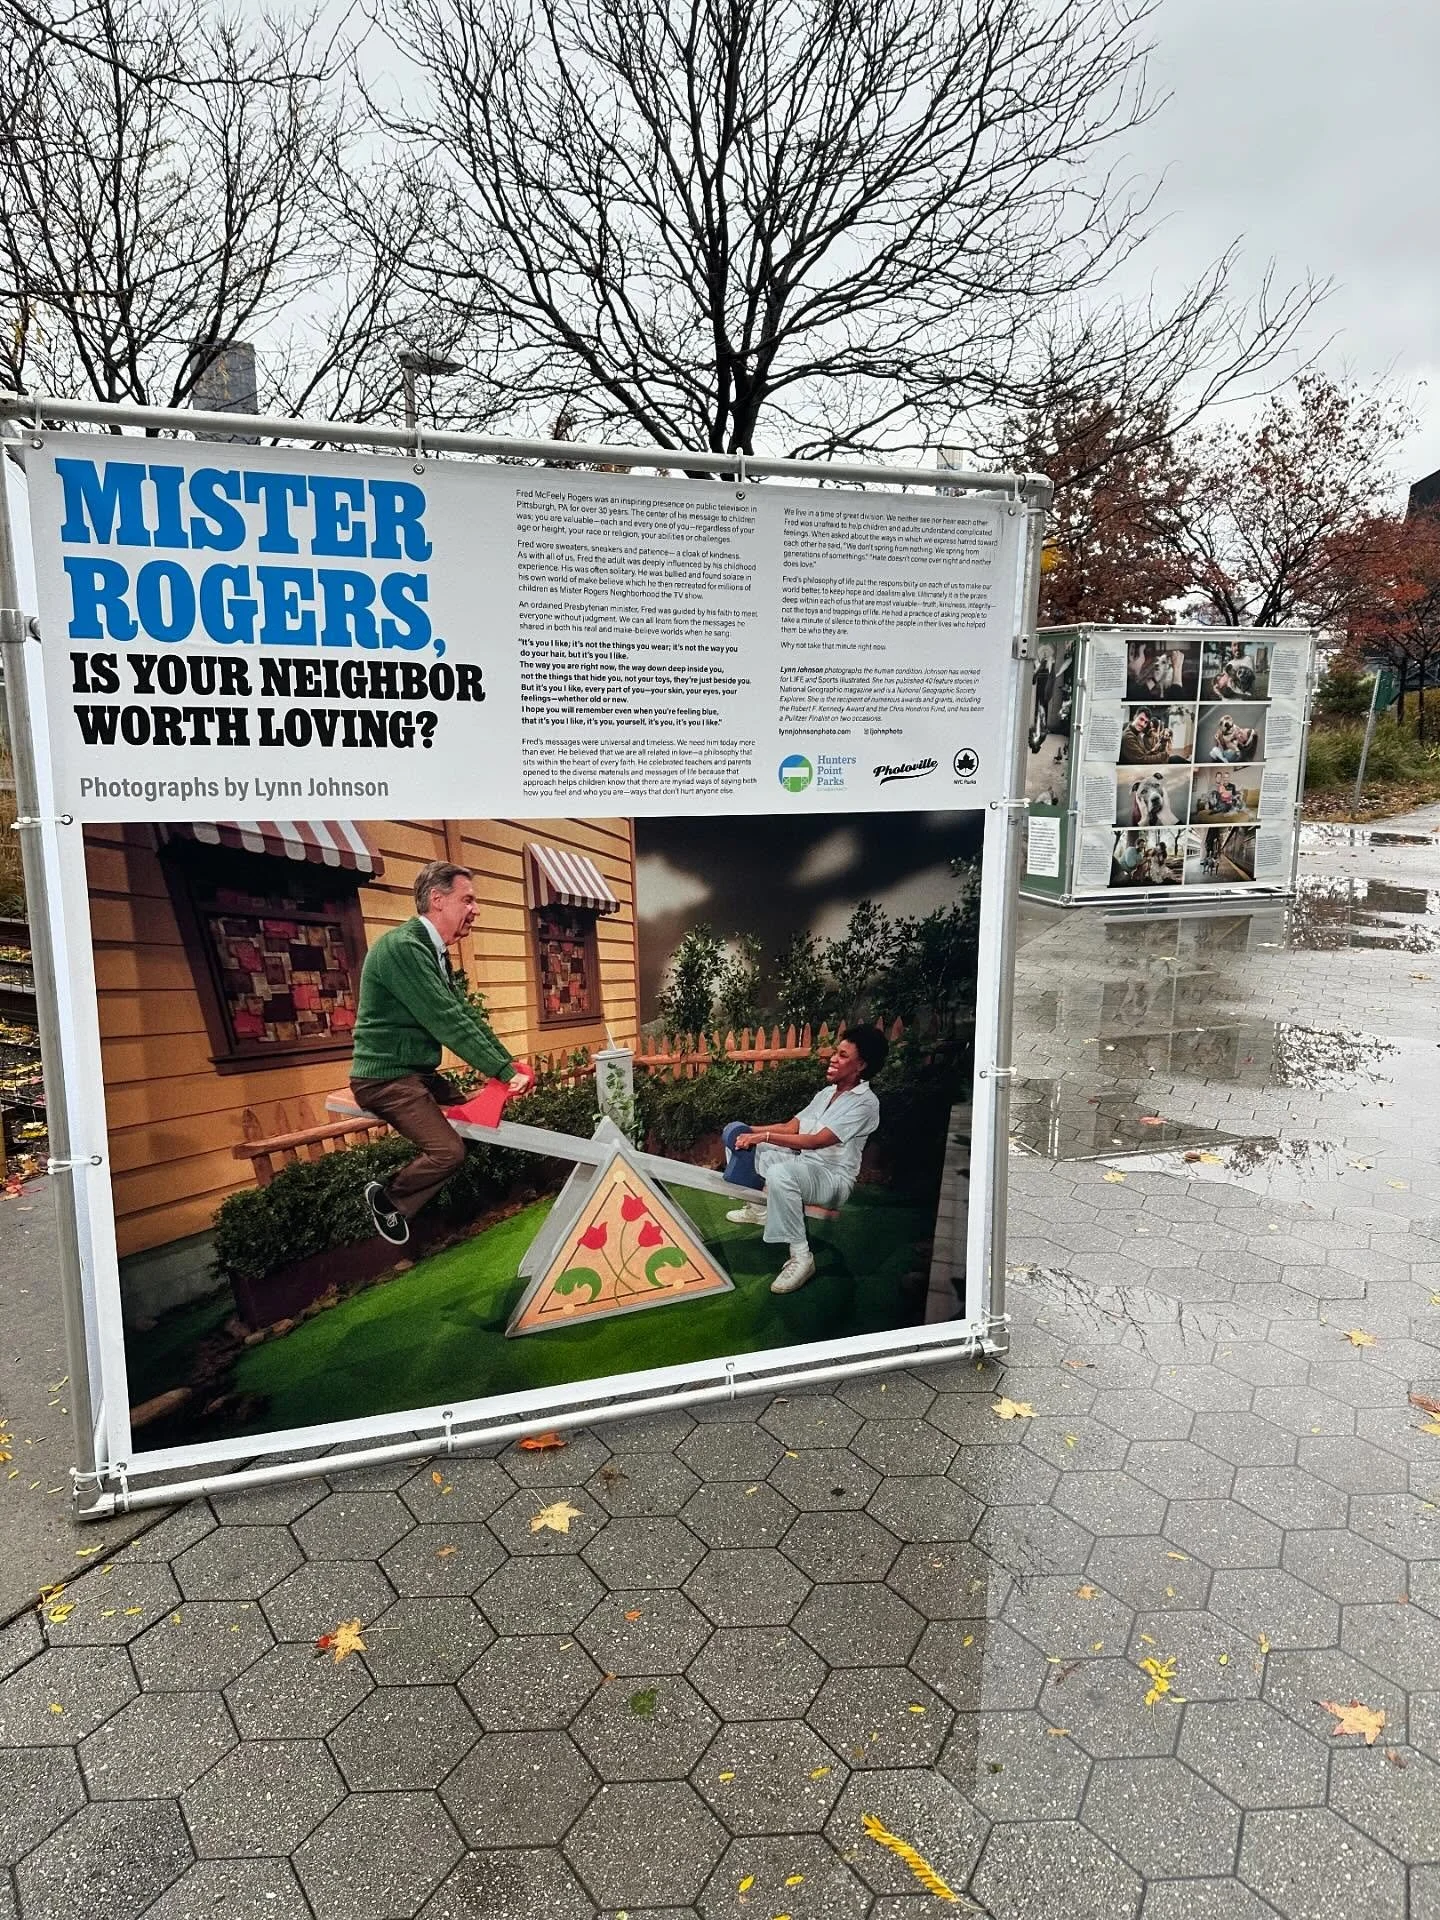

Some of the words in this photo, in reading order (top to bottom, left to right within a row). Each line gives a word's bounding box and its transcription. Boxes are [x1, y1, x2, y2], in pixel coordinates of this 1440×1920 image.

[55, 459, 432, 562] MISTER
[64, 556, 445, 657] ROGERS,
[518, 638, 534, 646] "It's
[554, 639, 571, 648] like;
[611, 642, 635, 652] things
[550, 650, 567, 658] hair,
[568, 650, 581, 658] but
[613, 650, 629, 660] like.
[519, 660, 534, 668] The
[535, 662, 551, 670] way
[552, 663, 565, 671] you
[580, 662, 598, 672] right
[668, 665, 686, 674] deep
[70, 653, 120, 693] IS
[127, 654, 252, 696] YOUR
[260, 658, 485, 701] NEIGHBOR
[548, 673, 573, 683] things
[655, 675, 672, 684] toys,
[673, 676, 698, 685] they're
[698, 676, 712, 685] just
[714, 676, 736, 684] beside
[568, 684, 583, 693] like,
[584, 686, 605, 695] every
[606, 686, 622, 694] part
[668, 686, 685, 695] skin,
[525, 705, 544, 714] hope
[654, 708, 676, 716] you're
[677, 708, 701, 716] feeling
[74, 705, 250, 746] WORTH
[258, 708, 437, 748] LOVING?
[570, 717, 585, 726] like,
[616, 718, 647, 727] yourself,
[817, 755, 856, 764] Hunters
[817, 766, 842, 775] Point
[873, 758, 938, 777] Photoville
[816, 777, 844, 786] Parks
[80, 777, 219, 802] Photographs
[224, 777, 249, 801] by
[255, 778, 302, 801] Lynn
[307, 777, 389, 797] Johnson
